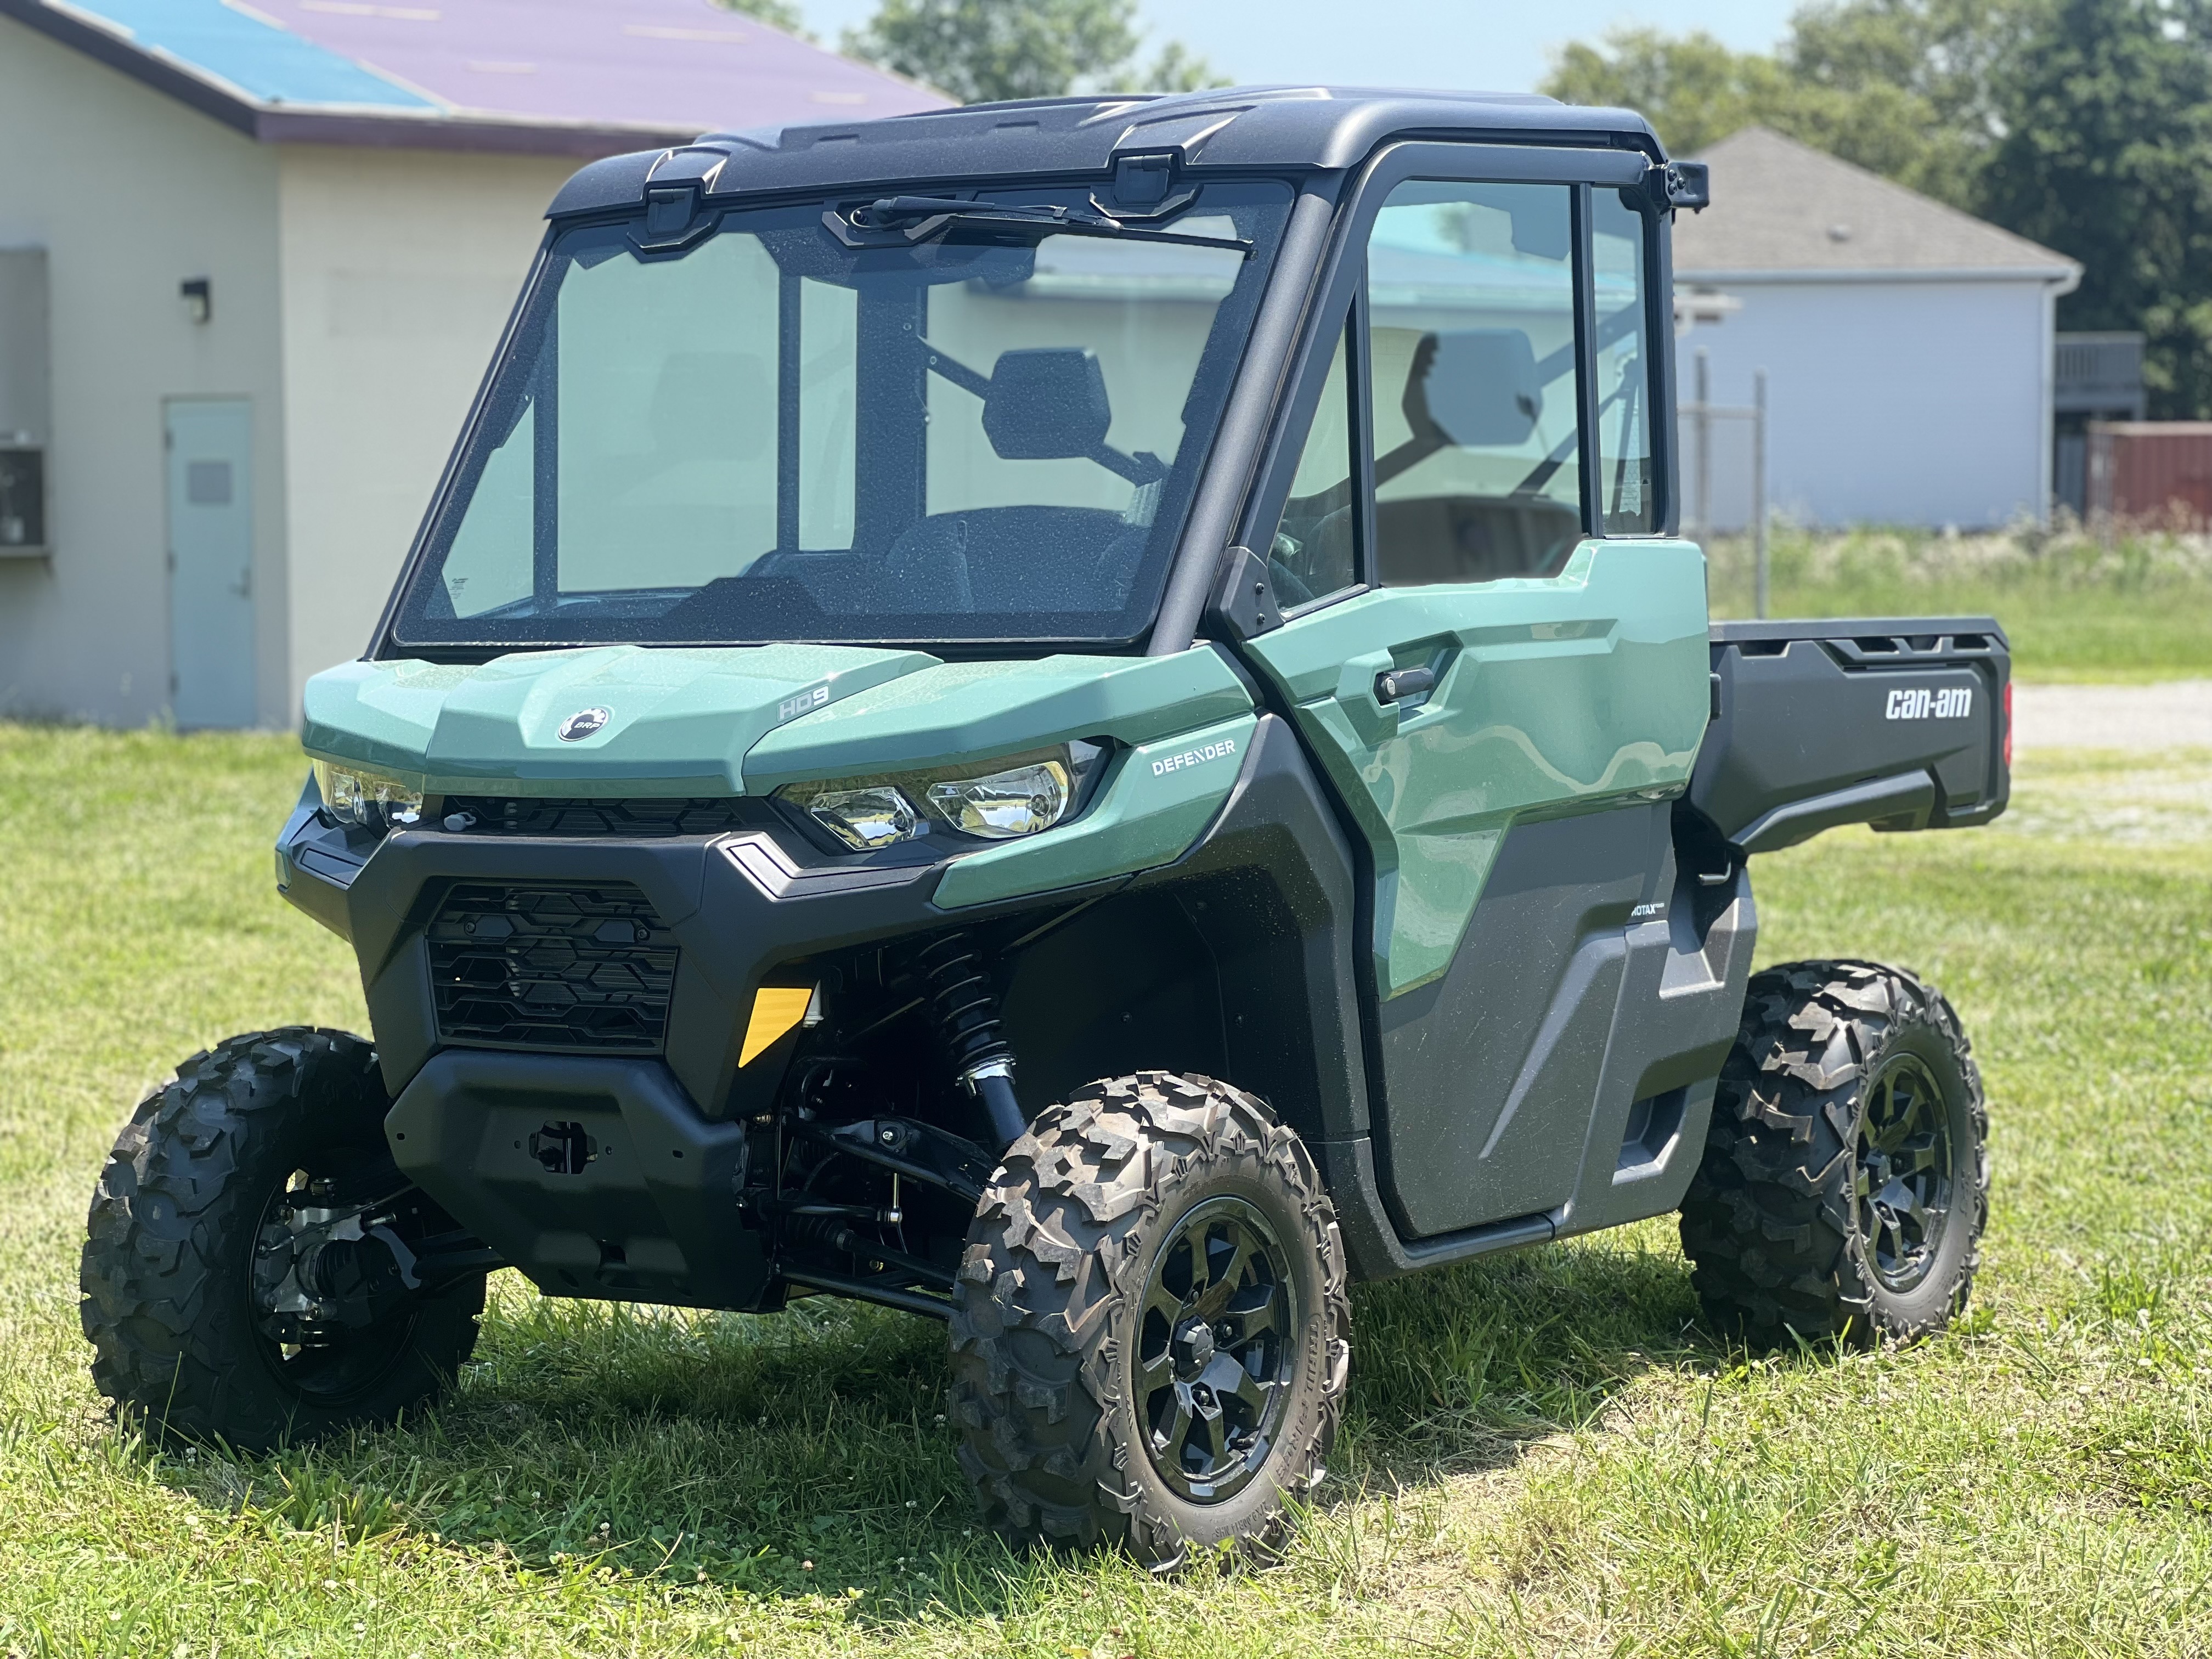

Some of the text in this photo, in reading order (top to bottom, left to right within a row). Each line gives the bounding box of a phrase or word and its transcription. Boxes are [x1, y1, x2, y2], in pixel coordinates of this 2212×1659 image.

[779, 685, 829, 720] HD9
[1886, 688, 1972, 719] can-am
[1152, 740, 1235, 776] DEFENDER
